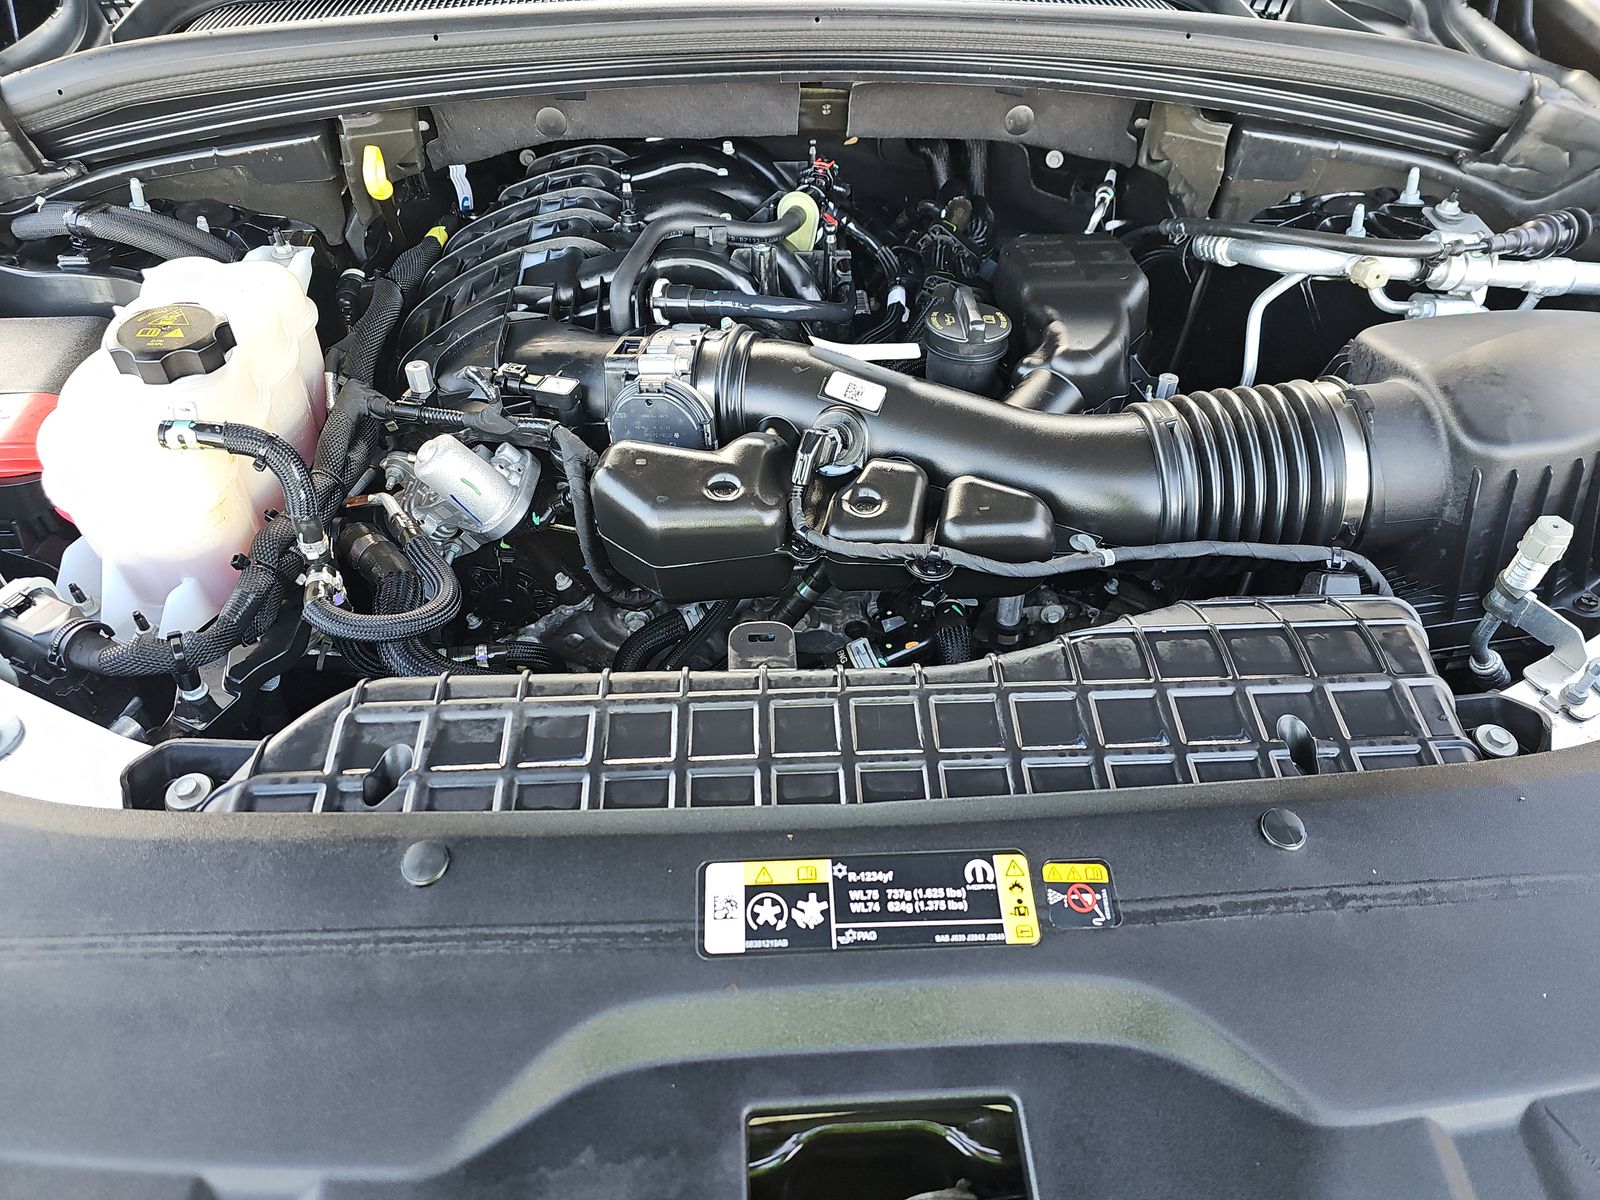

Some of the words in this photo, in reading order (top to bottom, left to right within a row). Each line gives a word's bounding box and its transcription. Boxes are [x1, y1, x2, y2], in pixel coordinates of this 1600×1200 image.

[836, 650, 848, 664] ENG
[848, 870, 894, 883] R-1234yf
[848, 889, 880, 901] WL75
[886, 888, 912, 901] 737g
[913, 887, 945, 900] (1.625
[945, 886, 967, 900] lbs)
[849, 901, 881, 913] WL74
[887, 900, 914, 914] 624g
[914, 899, 947, 913] (1.375
[947, 899, 968, 912] lbs)
